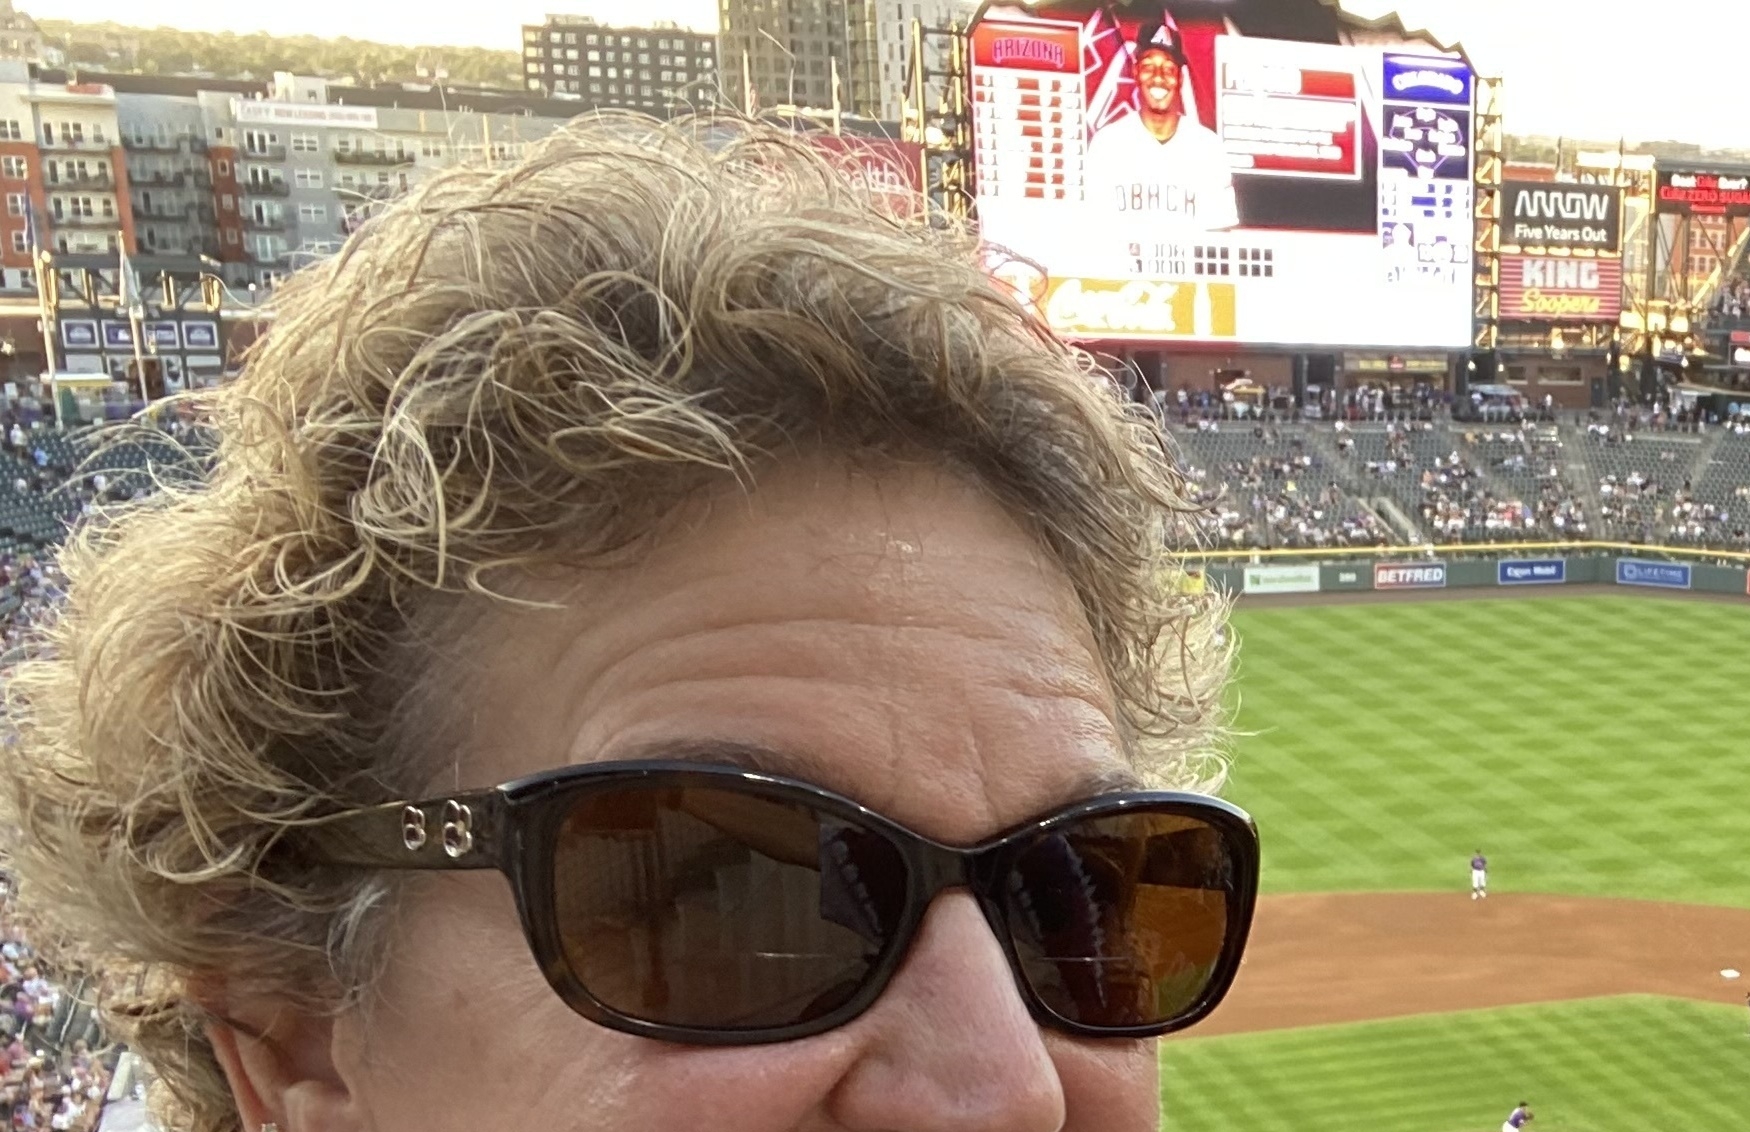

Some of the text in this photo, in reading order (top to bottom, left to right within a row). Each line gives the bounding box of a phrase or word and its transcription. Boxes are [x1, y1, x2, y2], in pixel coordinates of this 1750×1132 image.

[991, 38, 1064, 68] ARIZONA
[1514, 190, 1609, 220] ARROW
[1514, 223, 1607, 242] Five Years Out
[1522, 259, 1599, 288] KING
[1520, 288, 1600, 316] Soopers
[1377, 568, 1443, 584] BETFRED
